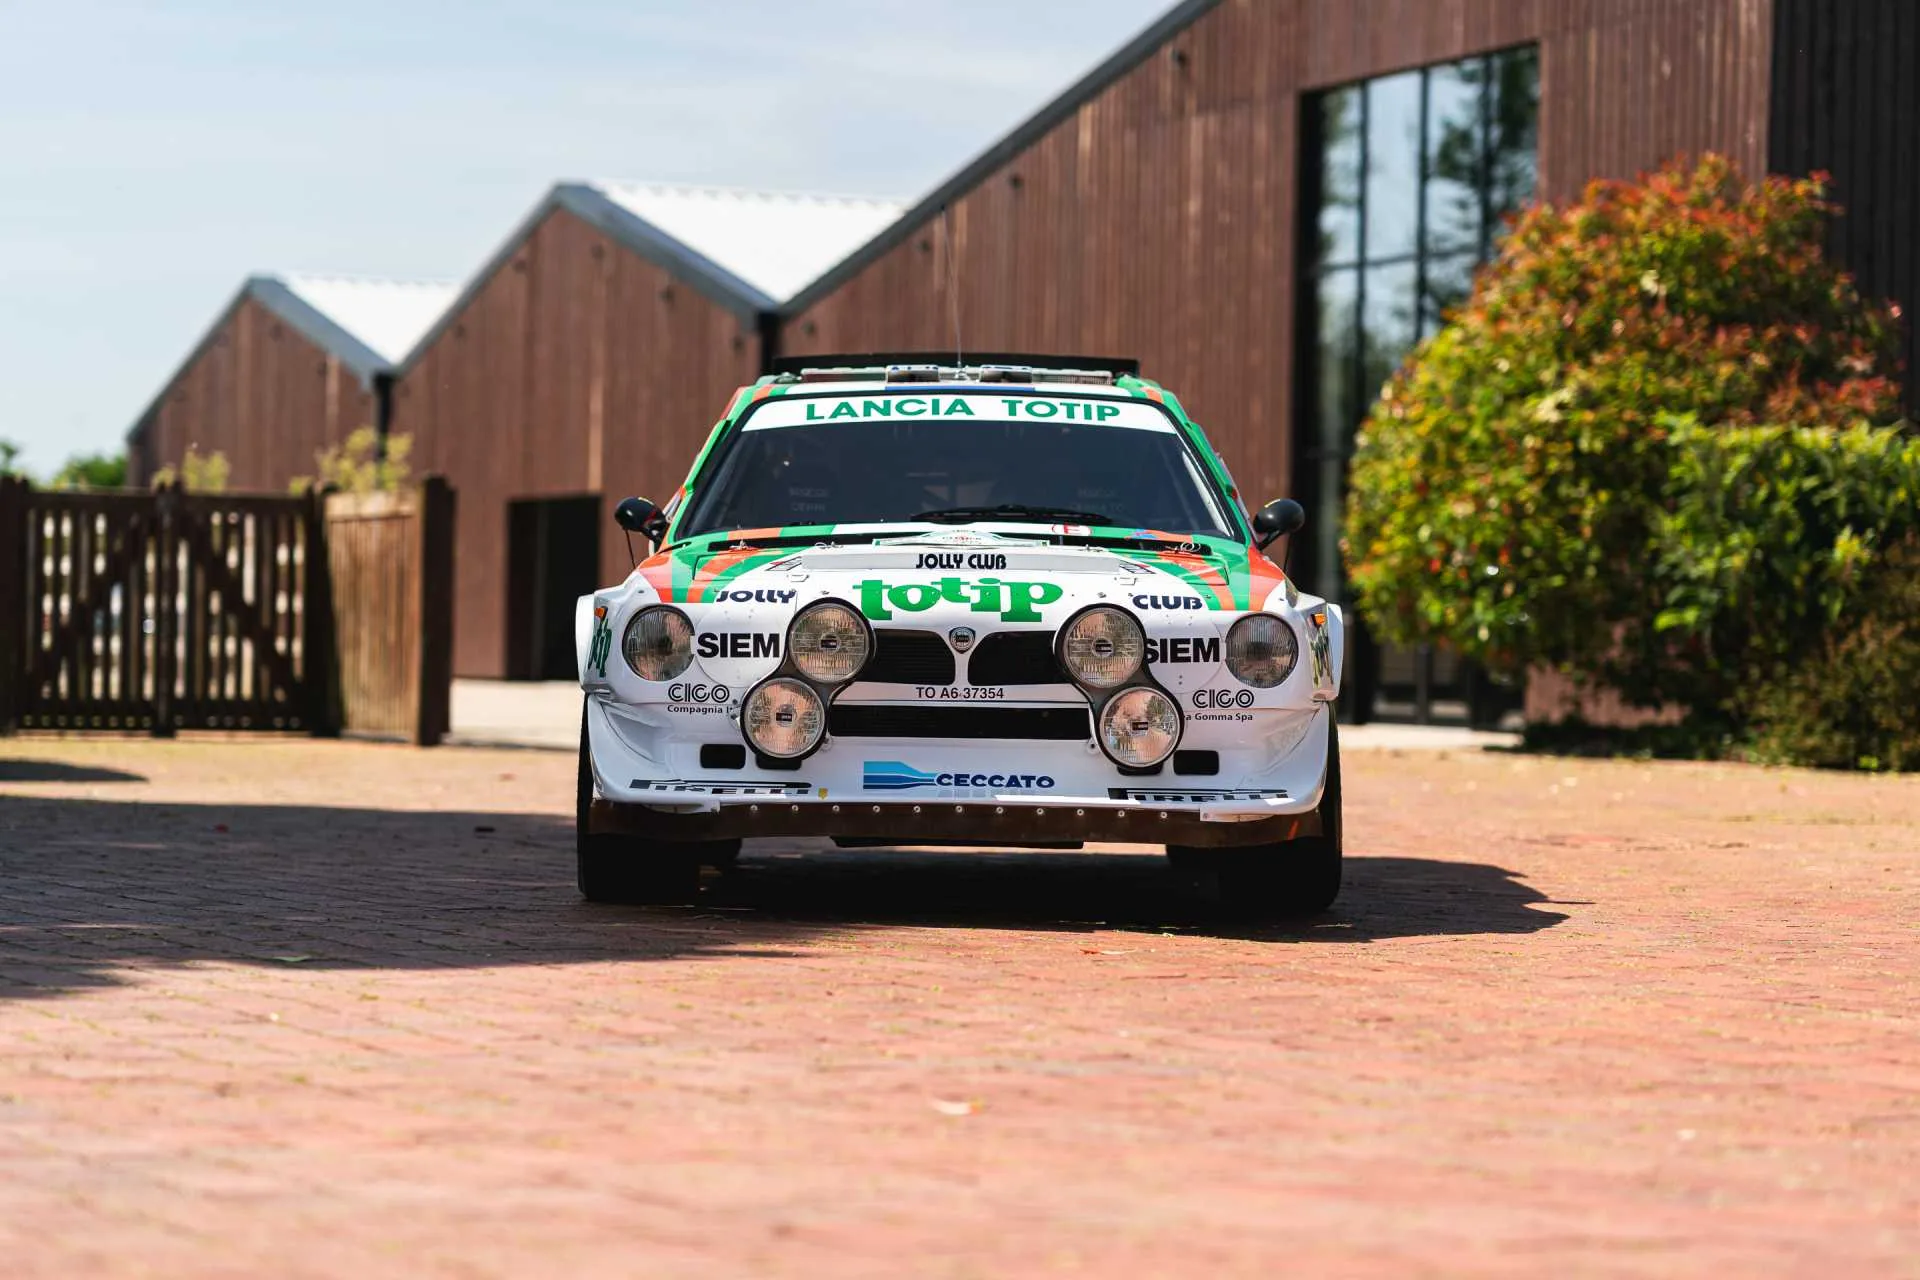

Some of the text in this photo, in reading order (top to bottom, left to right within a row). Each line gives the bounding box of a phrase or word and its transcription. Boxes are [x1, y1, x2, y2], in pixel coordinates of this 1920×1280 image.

[806, 398, 1120, 421] LANCIA TOTIP
[916, 553, 1007, 570] JOLLY CLUB
[716, 589, 796, 604] JOLLY
[852, 577, 1063, 622] totip
[1132, 594, 1203, 610] CLUB
[697, 632, 780, 658] SIEM
[1145, 637, 1220, 664] SIEM
[916, 687, 936, 699] TO
[667, 704, 723, 715] Compagnia
[1194, 712, 1233, 721] Gomma
[1235, 712, 1253, 722] Spa
[629, 779, 812, 795] PIRELLI
[936, 773, 1055, 788] CECCATO
[1107, 787, 1289, 802] PIRELLI
